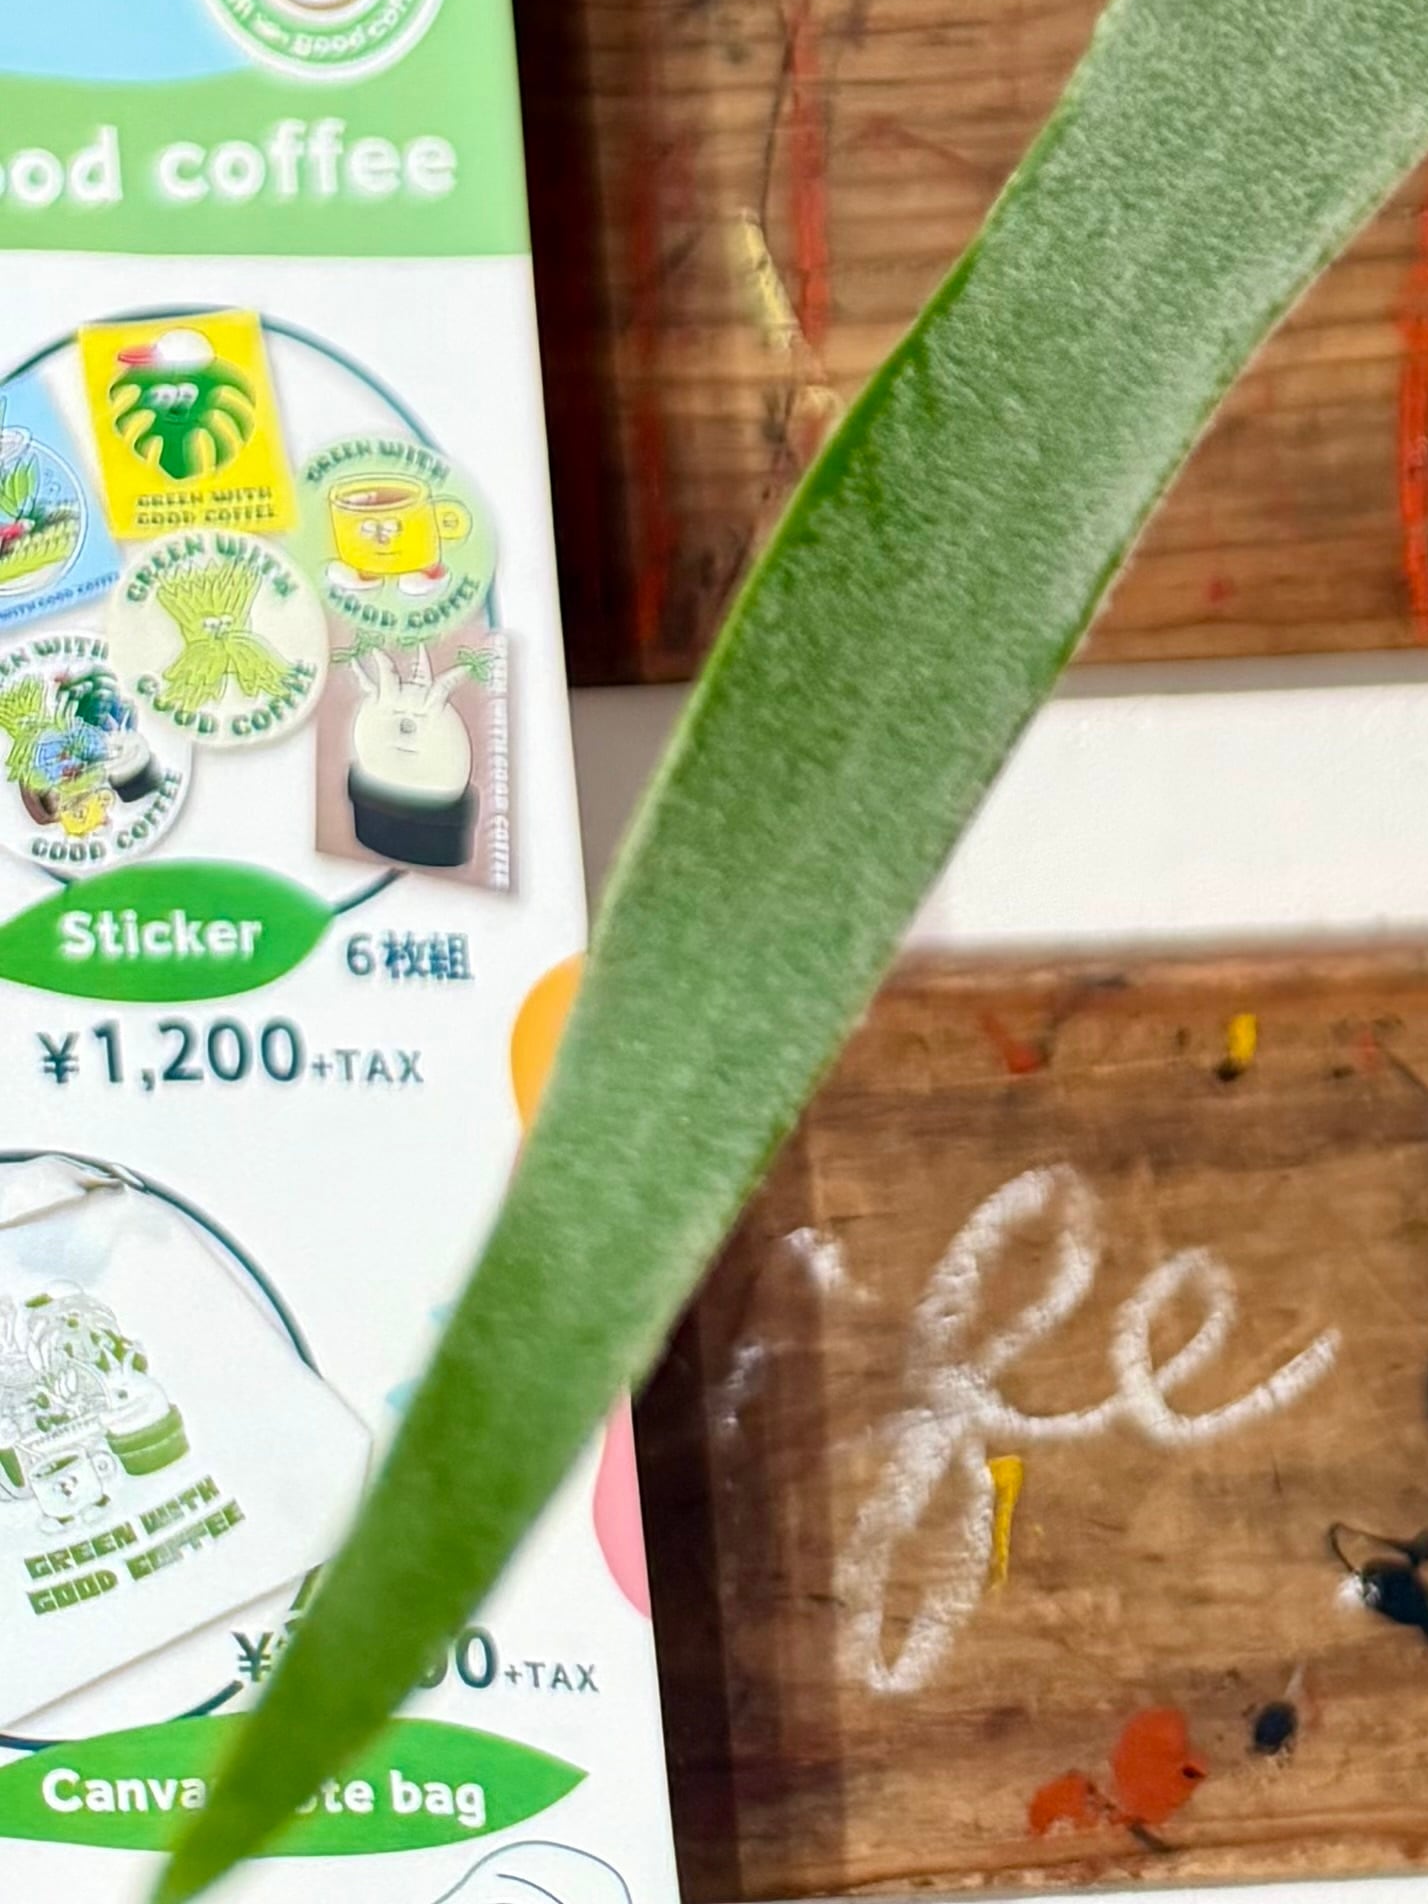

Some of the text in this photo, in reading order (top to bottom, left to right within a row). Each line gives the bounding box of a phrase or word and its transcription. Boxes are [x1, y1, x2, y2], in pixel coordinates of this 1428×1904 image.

[158, 120, 456, 202] coffee
[59, 908, 263, 961] Sticker
[346, 930, 472, 982] 6枚組
[28, 1569, 118, 1616] GOOD
[42, 1769, 206, 1814] Canva
[390, 1769, 486, 1828] bag
